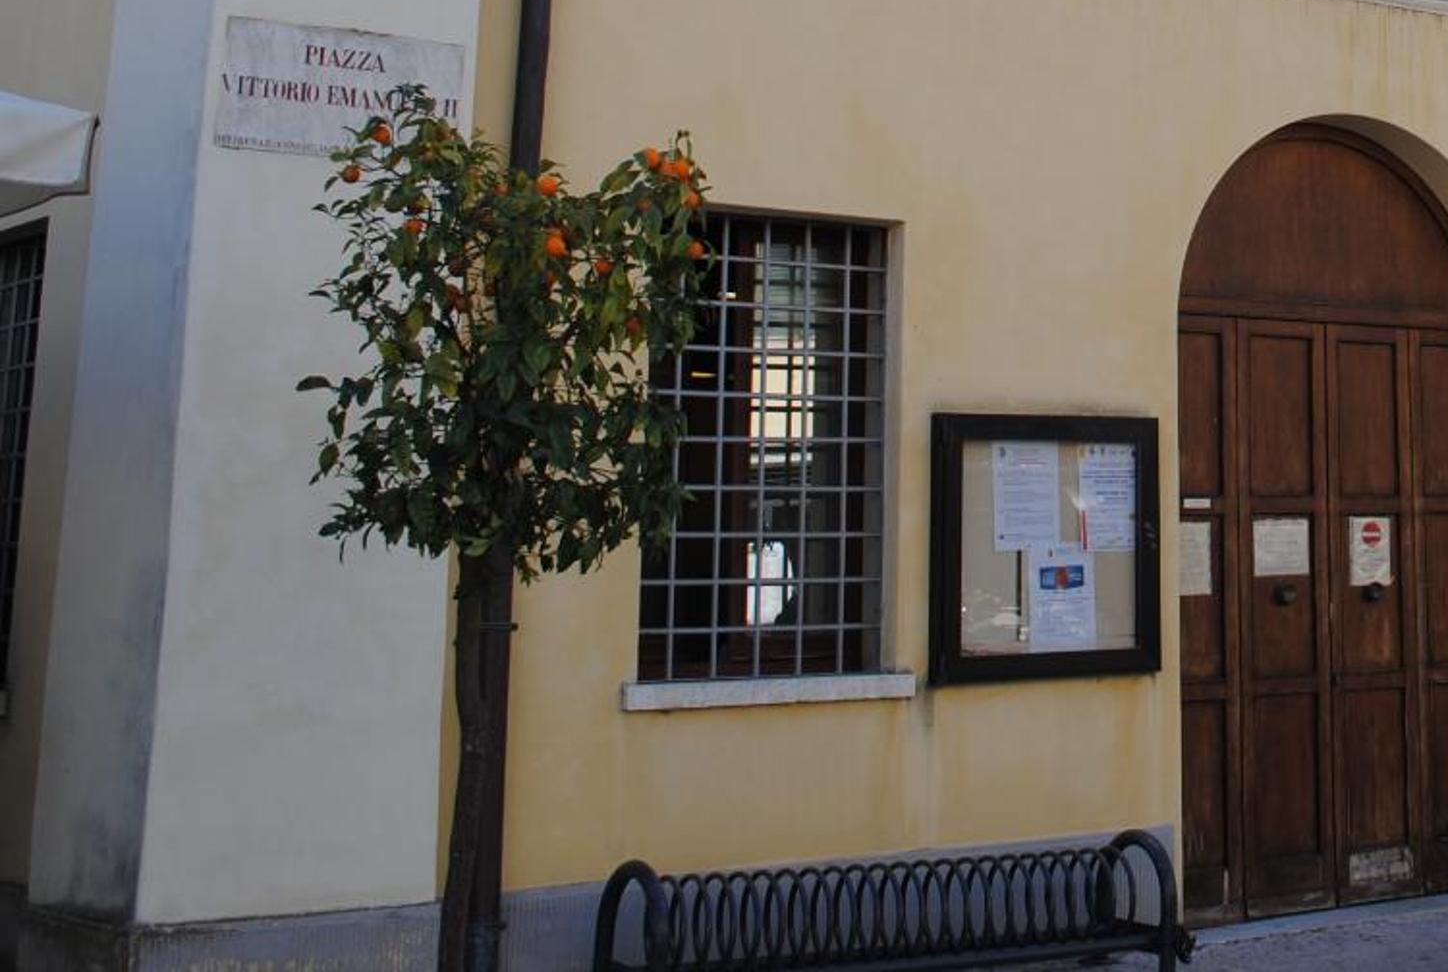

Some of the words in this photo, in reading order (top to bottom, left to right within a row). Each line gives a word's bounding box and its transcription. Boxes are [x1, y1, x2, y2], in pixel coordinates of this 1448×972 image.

[303, 44, 387, 74] PIAZZA
[221, 73, 321, 104] VITTORIO
[443, 98, 460, 120] II
